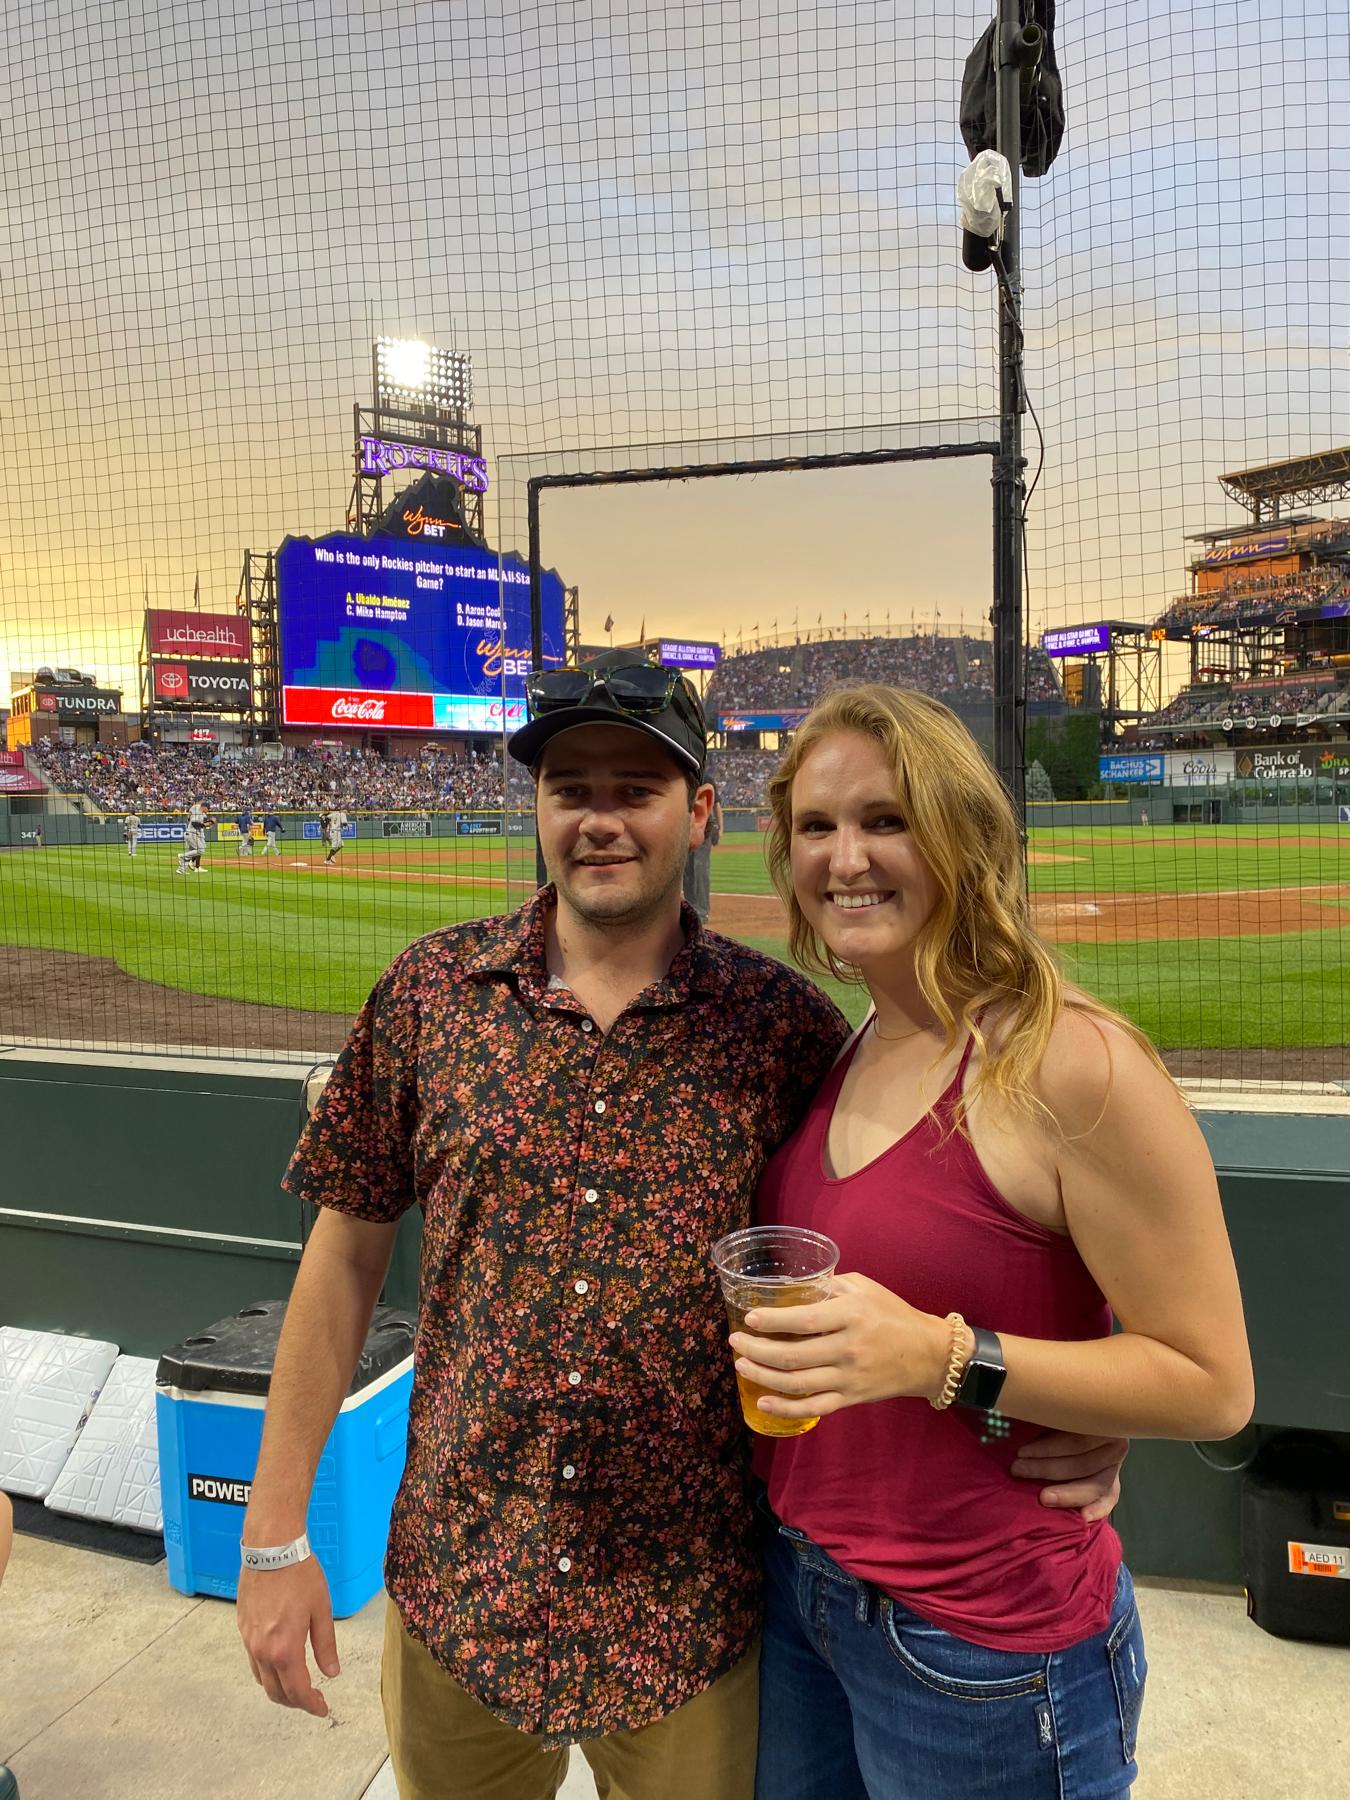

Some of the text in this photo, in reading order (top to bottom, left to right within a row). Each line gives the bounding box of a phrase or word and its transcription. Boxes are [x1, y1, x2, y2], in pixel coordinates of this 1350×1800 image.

[361, 437, 489, 491] ROCKIES
[424, 524, 445, 537] BET
[315, 548, 334, 562] Who
[336, 550, 344, 563] is
[346, 552, 360, 565] the
[362, 555, 380, 570] only
[382, 556, 413, 572] Rockies
[415, 560, 444, 575] pitcher
[445, 564, 454, 576] to
[455, 566, 475, 578] start
[477, 570, 486, 579] an
[501, 570, 531, 585] All-Sta
[416, 575, 444, 590] Game?
[346, 592, 354, 603] A.
[356, 593, 380, 606] Ubaldo
[346, 604, 407, 622] C. Mike Hampton
[456, 603, 464, 614] B.
[465, 603, 485, 616] Aaron
[457, 615, 464, 626] D.
[465, 616, 484, 628] Jason
[166, 624, 236, 645] uchealth
[189, 675, 249, 690] TOYOTA
[56, 696, 116, 710] TUNDRA
[331, 697, 387, 720] Coca-Cola
[1254, 750, 1301, 766] Bank of
[1110, 761, 1144, 770] BACHUS
[1182, 760, 1217, 774] Coors
[1254, 764, 1312, 779] Colorado
[1100, 768, 1143, 778] SCHANKER
[1309, 1553, 1343, 1564] AED 11
